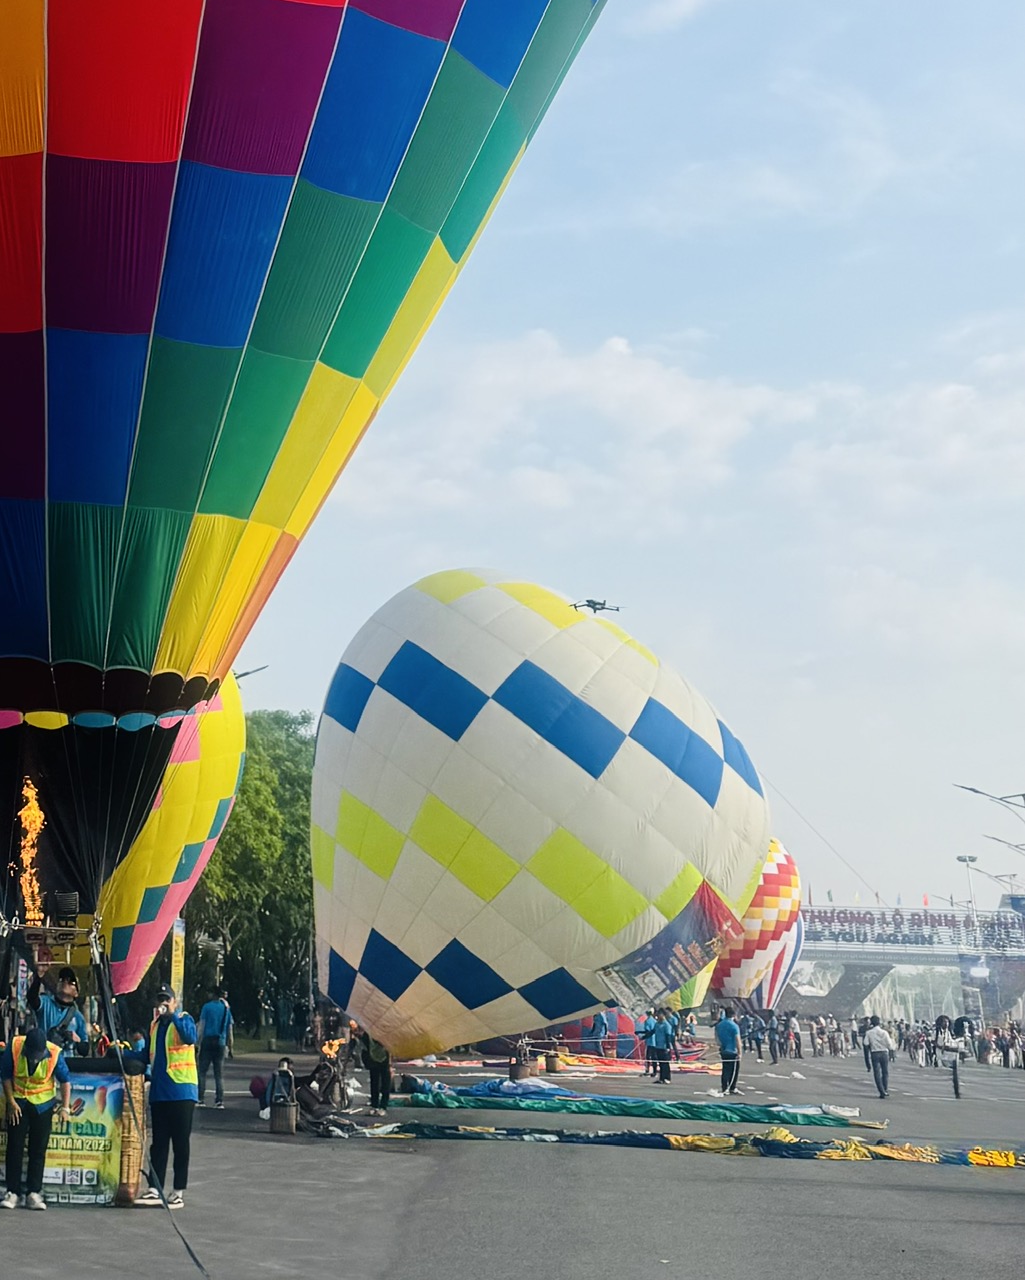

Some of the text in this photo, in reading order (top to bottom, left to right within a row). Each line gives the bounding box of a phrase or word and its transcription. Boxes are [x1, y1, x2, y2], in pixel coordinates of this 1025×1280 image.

[832, 931, 869, 943] YOU
[876, 931, 934, 945] AGAIN
[84, 1137, 112, 1151] 2025
